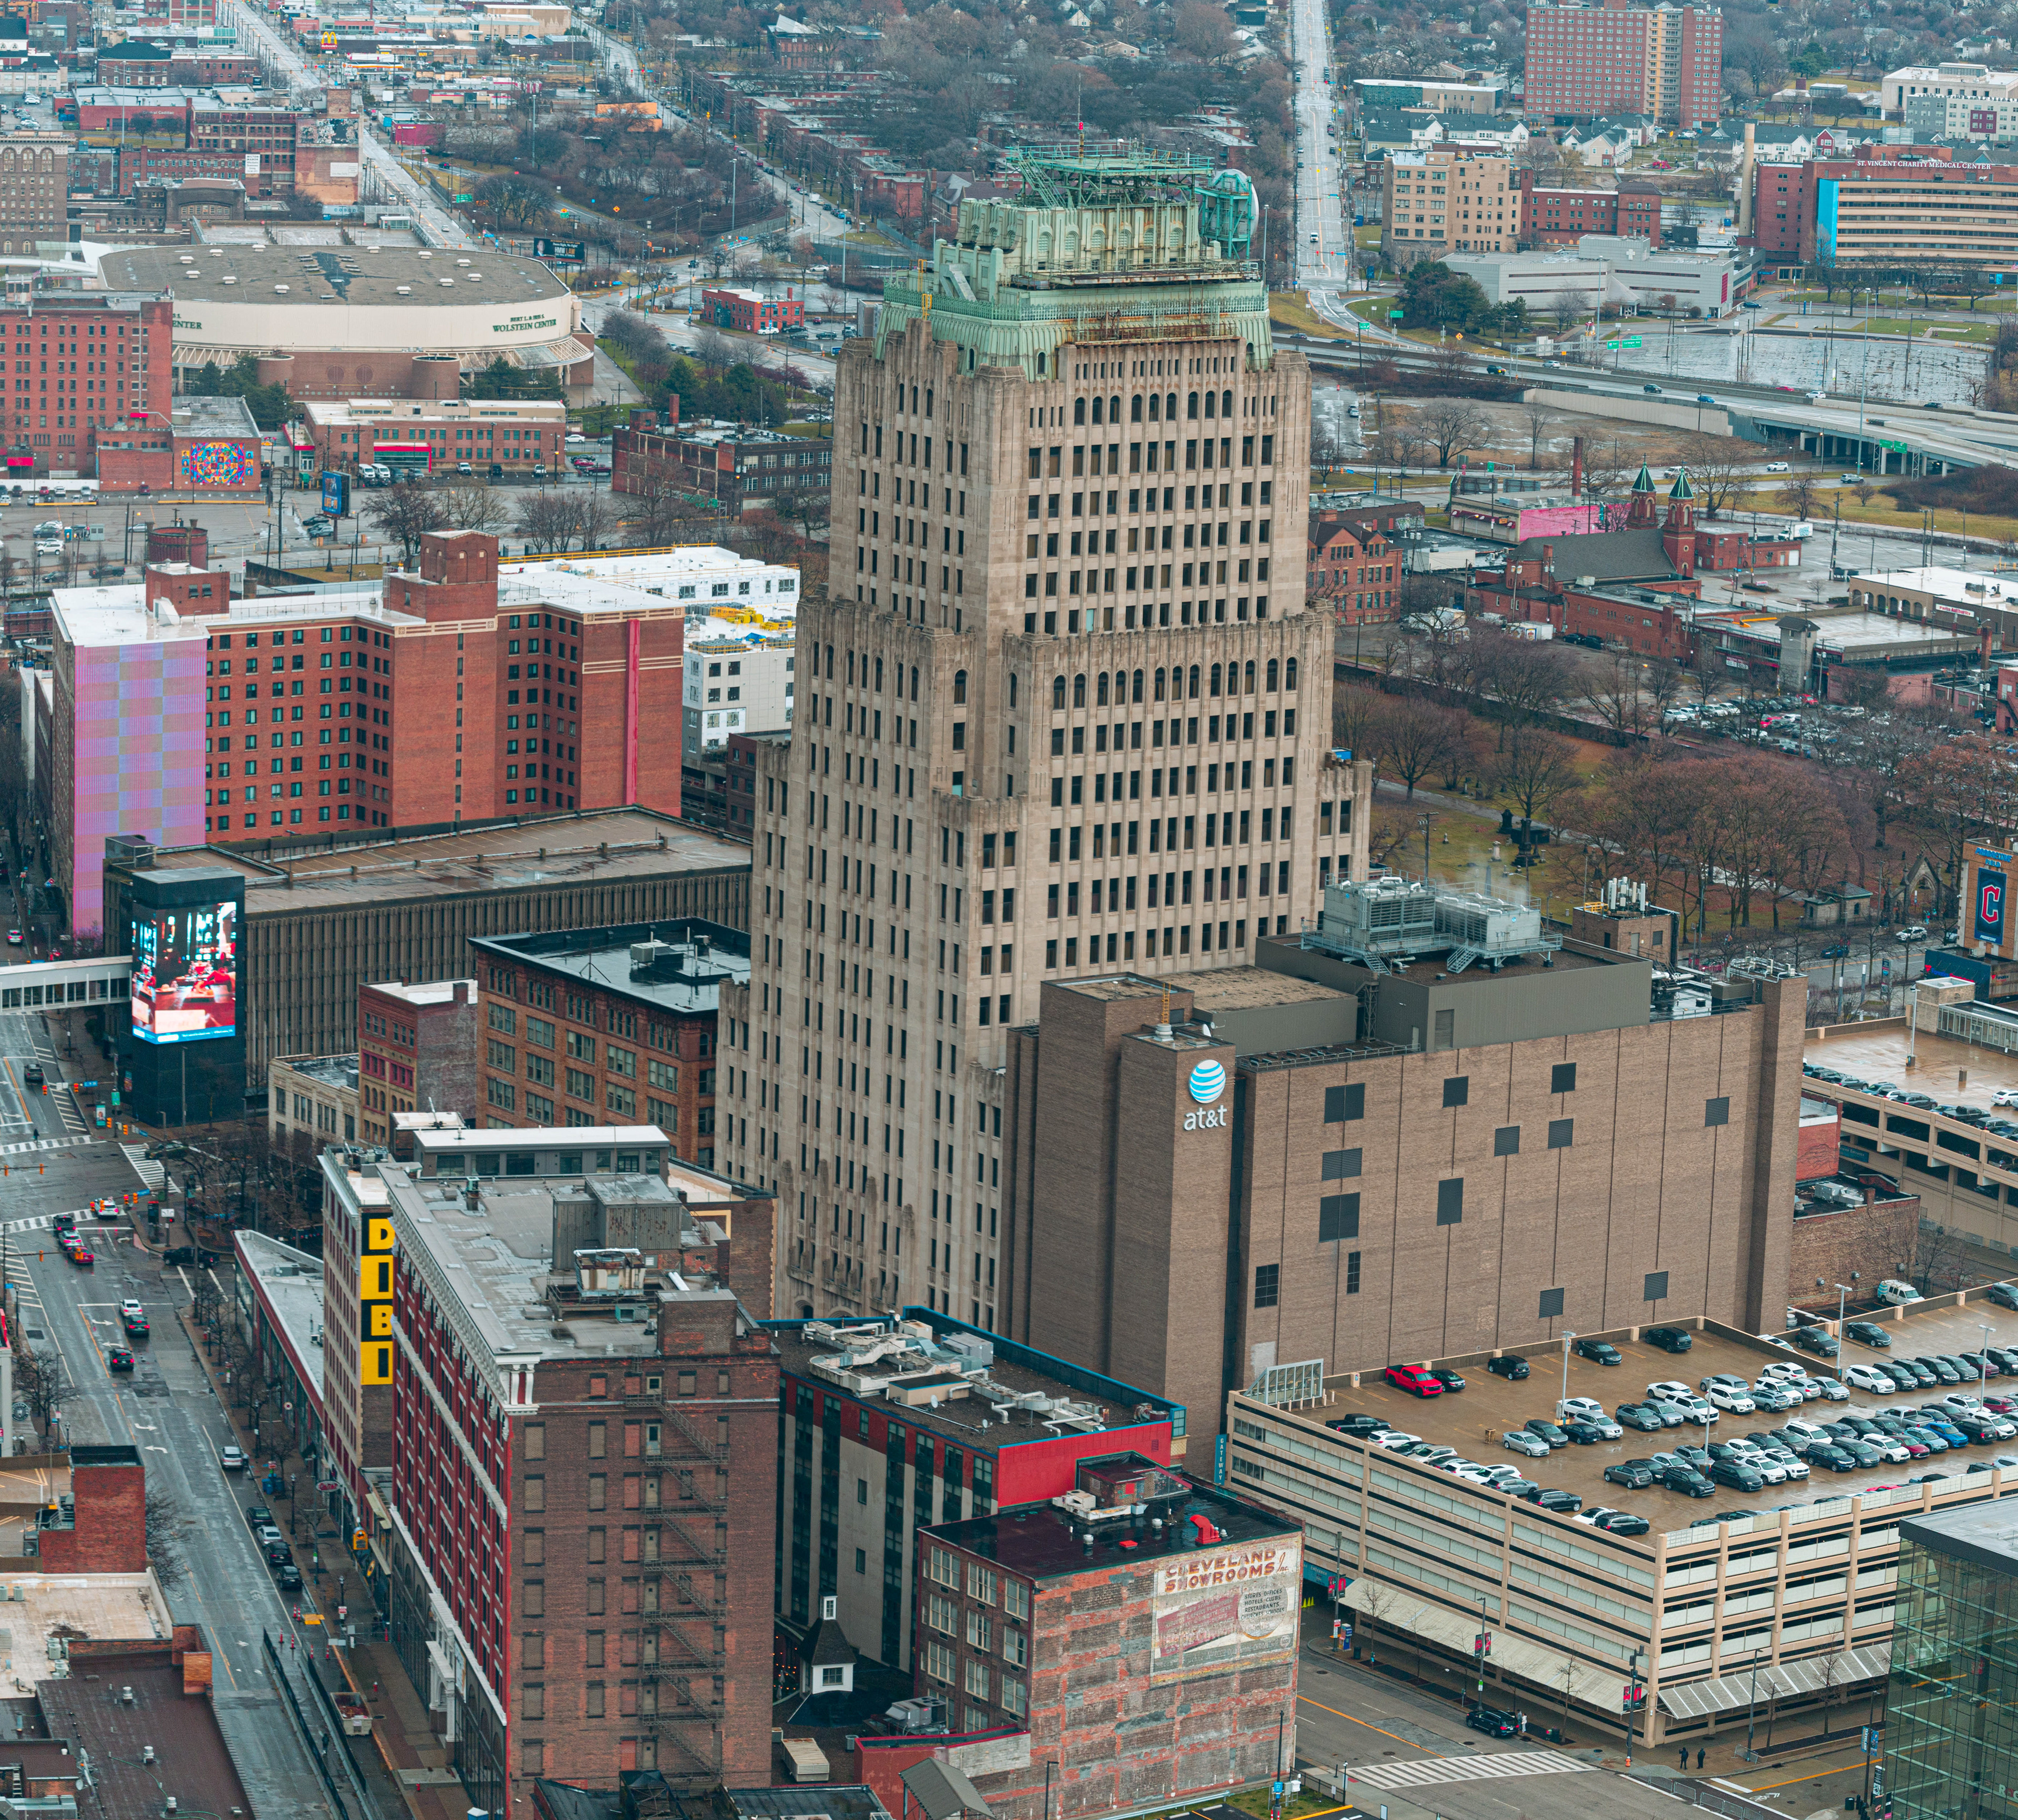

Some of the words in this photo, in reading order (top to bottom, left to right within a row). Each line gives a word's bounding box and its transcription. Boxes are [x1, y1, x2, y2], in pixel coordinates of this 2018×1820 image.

[172, 320, 202, 330] ENTER
[492, 322, 533, 332] WOLSTEIN
[534, 319, 557, 329] CENTER
[1975, 847, 2013, 862] PROGRESSIVE
[1985, 859, 2001, 868] FIELD
[1981, 885, 2001, 924] C
[1183, 1105, 1228, 1131] at&t
[1166, 1548, 1276, 1578] CLEVELAND
[1165, 1562, 1275, 1592] SHOWROOMS
[1311, 1565, 1327, 1576] Entrance
[1207, 1598, 1233, 1612] FURNITURE
[1244, 1602, 1279, 1612] RESTAURANTS
[1241, 1611, 1263, 1620] CHURCHES
